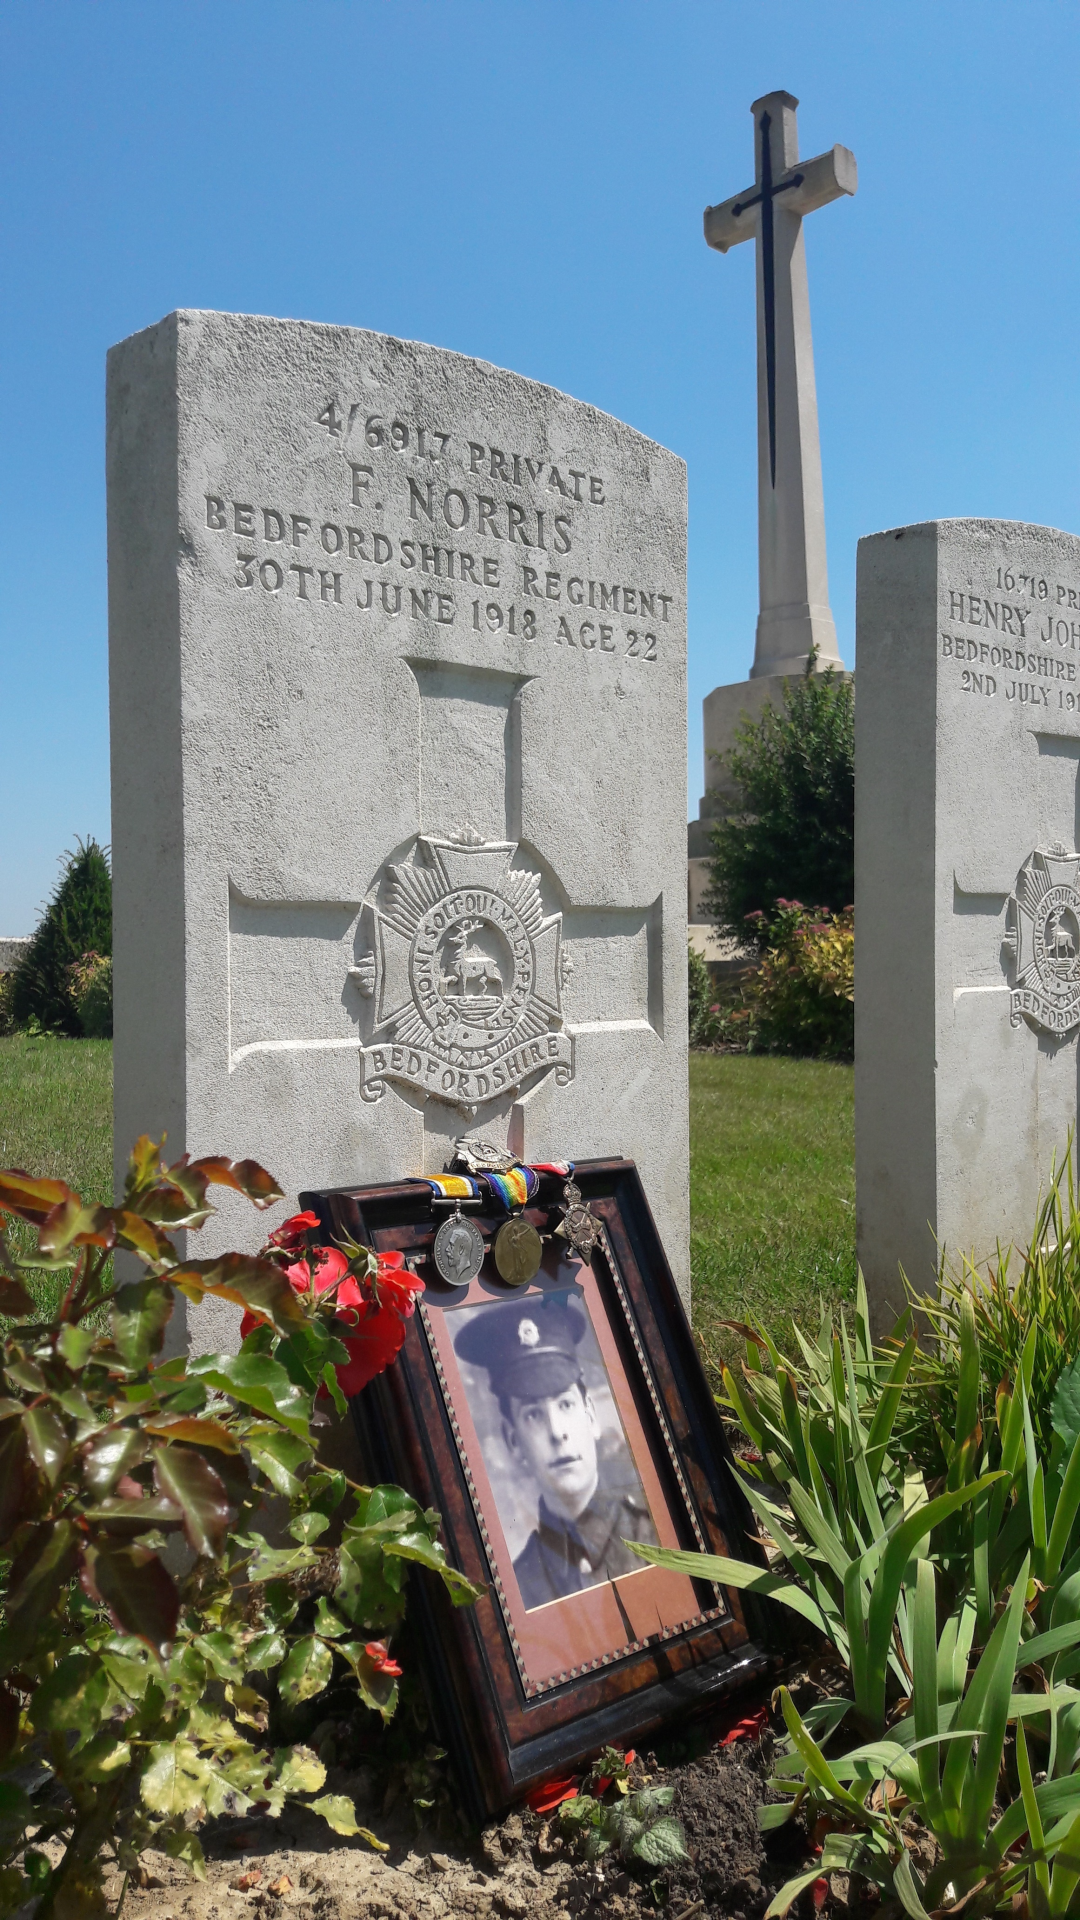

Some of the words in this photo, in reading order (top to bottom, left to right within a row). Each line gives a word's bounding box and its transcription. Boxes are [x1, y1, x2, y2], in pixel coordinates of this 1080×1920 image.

[313, 402, 451, 463] 4/6917
[467, 441, 606, 505] PRIVATE
[350, 462, 382, 510] F.
[407, 477, 572, 556] NORRIS
[204, 495, 500, 588] BEDFORDSHIRE
[522, 566, 673, 622] REGIMENT
[996, 566, 1048, 600] 16719
[233, 553, 343, 604] 30TH
[356, 579, 455, 625] JUNE
[472, 599, 536, 641] 1918
[554, 616, 615, 654] AGE
[623, 629, 657, 661] 22
[949, 590, 1031, 637] HENRY
[941, 633, 1076, 681] BEDFORDSHIRE
[960, 670, 996, 697] 2ND
[1005, 681, 1051, 706] JULY
[373, 1036, 560, 1098] BEDFORDSHIRE
